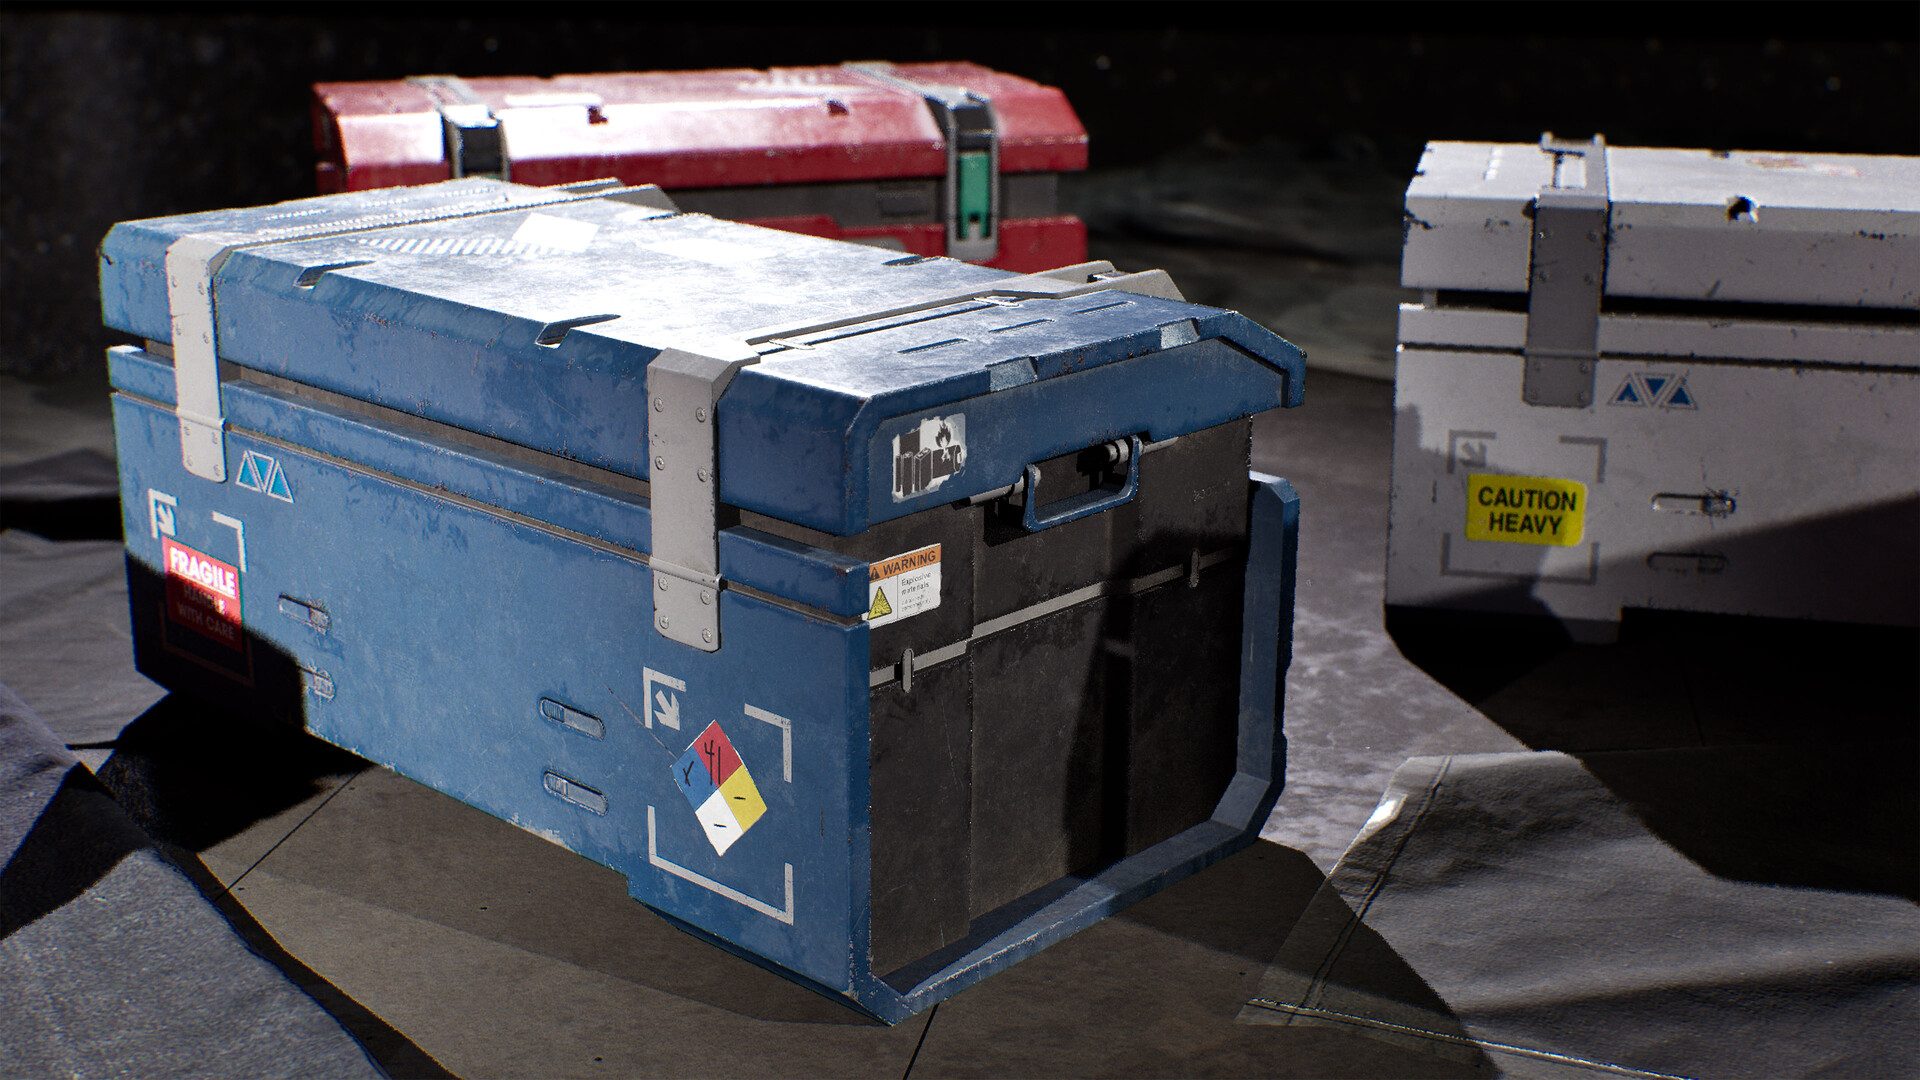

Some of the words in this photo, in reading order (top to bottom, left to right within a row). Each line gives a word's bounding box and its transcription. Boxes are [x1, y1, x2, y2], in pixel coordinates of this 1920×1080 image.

[1478, 486, 1577, 511] CAUTION
[1489, 512, 1562, 535] HEAVY
[169, 546, 237, 597] FRAGILE
[883, 550, 937, 576] WARNING
[901, 572, 932, 587] Explosive
[901, 582, 930, 596] materials
[176, 601, 204, 626] WITH
[207, 613, 238, 640] CARE
